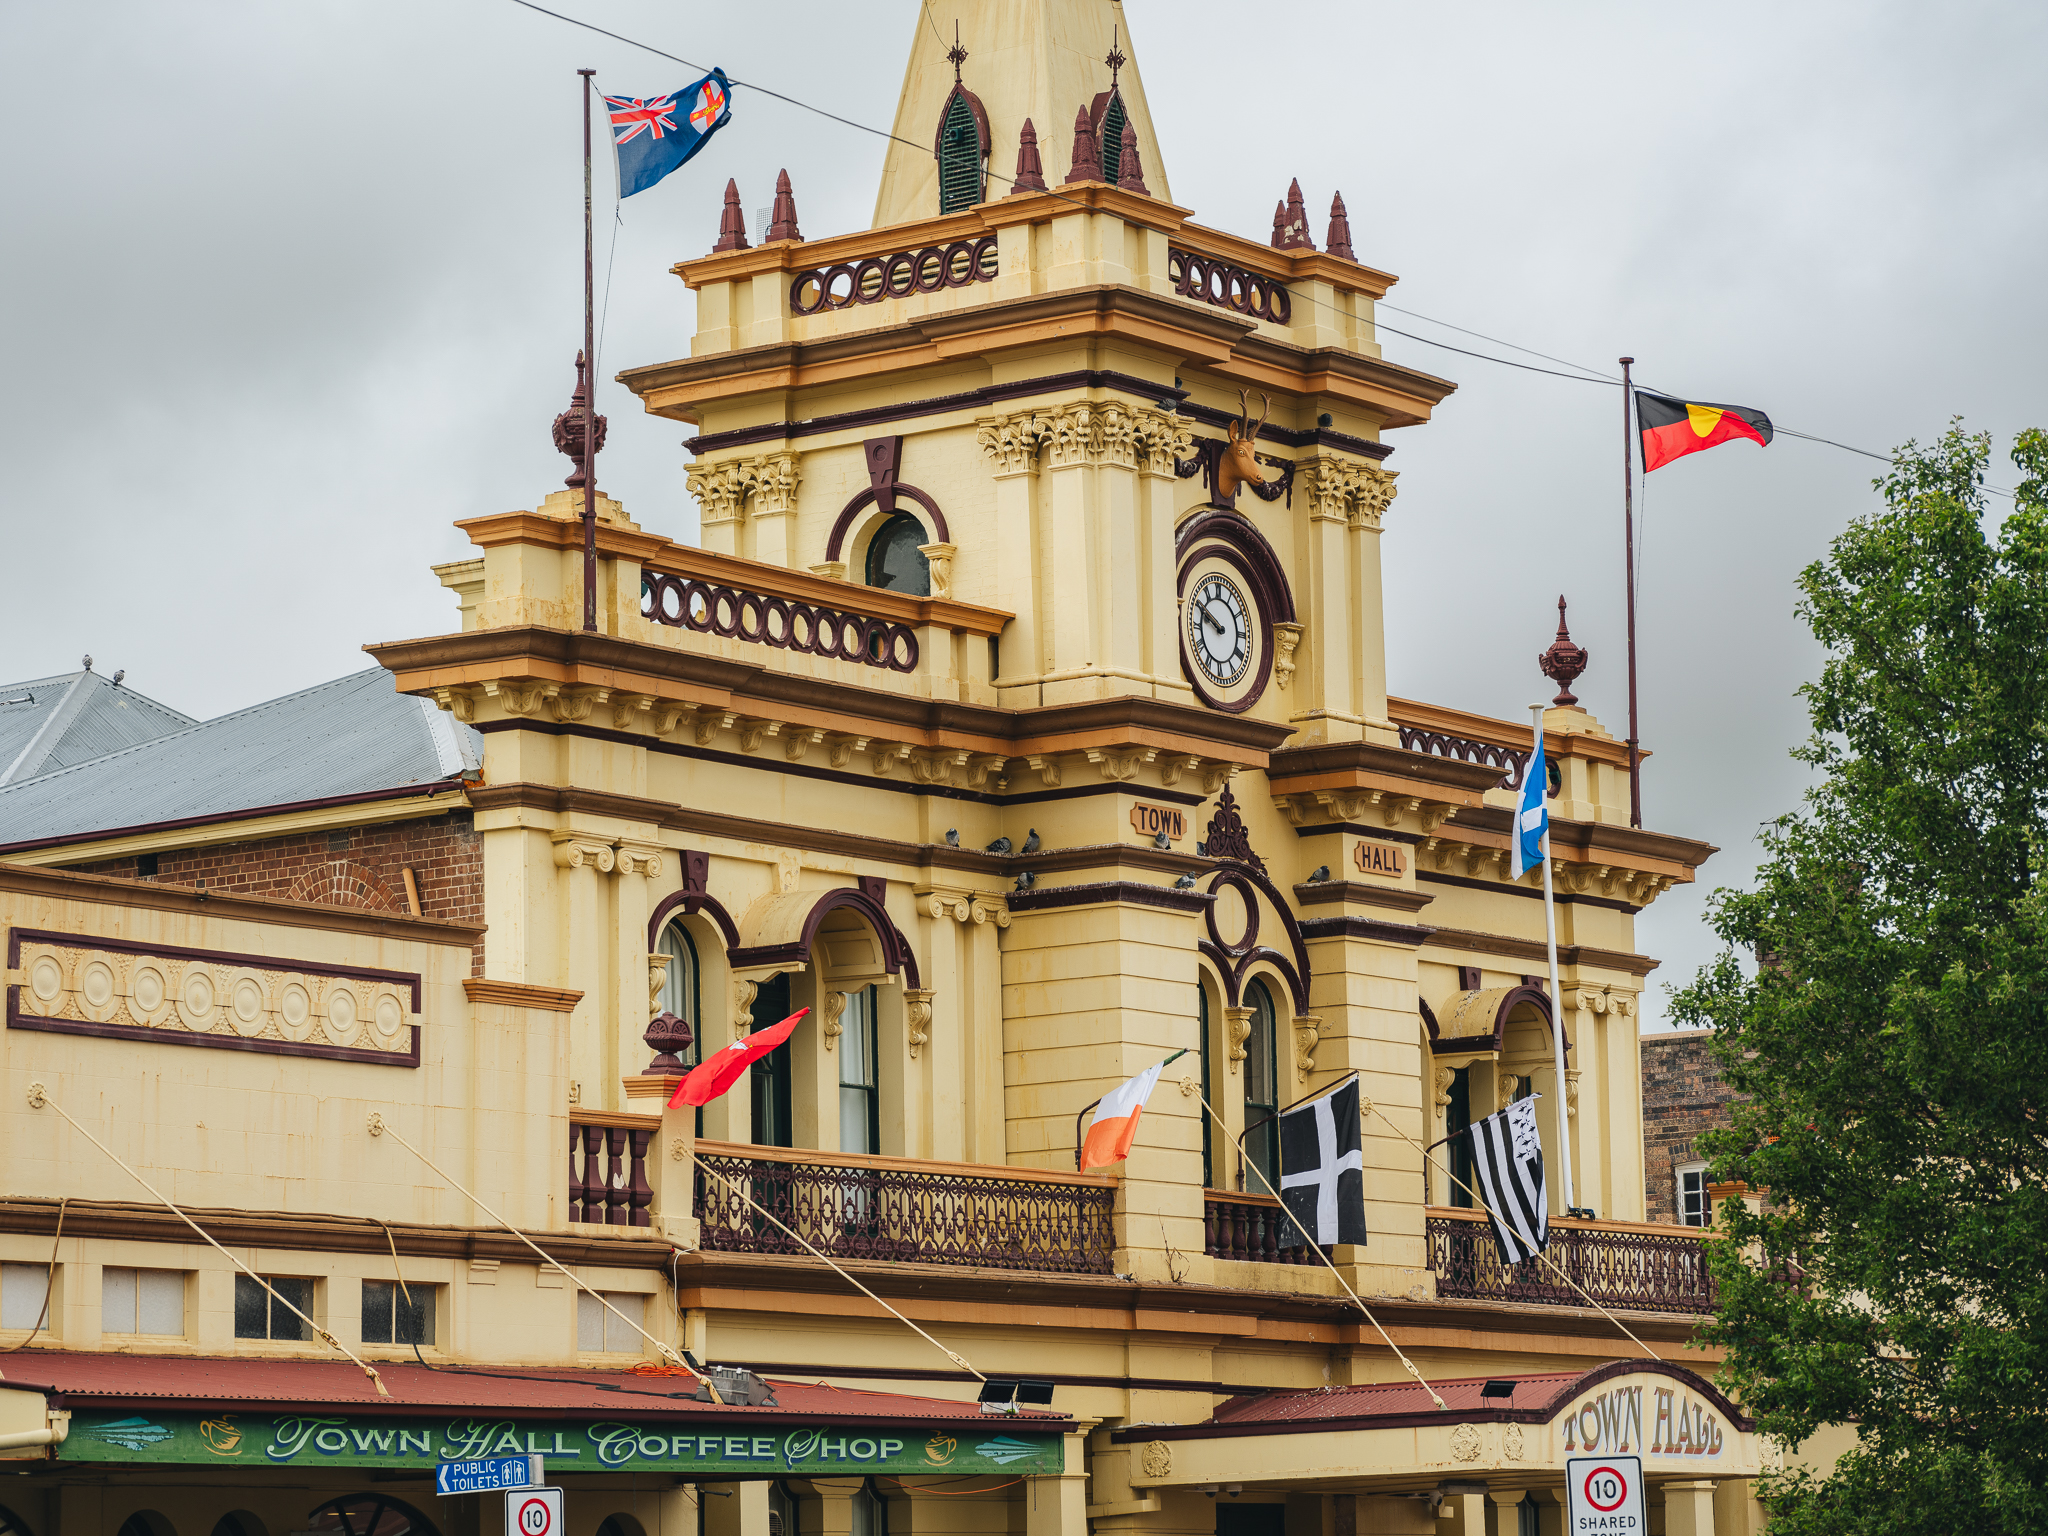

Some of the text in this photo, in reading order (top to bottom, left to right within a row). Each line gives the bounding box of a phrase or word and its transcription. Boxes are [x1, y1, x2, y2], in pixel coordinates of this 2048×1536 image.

[1138, 806, 1182, 836] TOWN
[1362, 845, 1402, 873] HALL
[1563, 1386, 1723, 1456] TOWN HALL
[266, 1415, 431, 1458] TOWN
[587, 1422, 776, 1464] COFFEE
[453, 1461, 497, 1476] PUBLIC
[452, 1475, 500, 1491] TOILETS
[1594, 1479, 1617, 1499] 10
[526, 1510, 543, 1528] 10
[1579, 1516, 1637, 1530] SHARED
